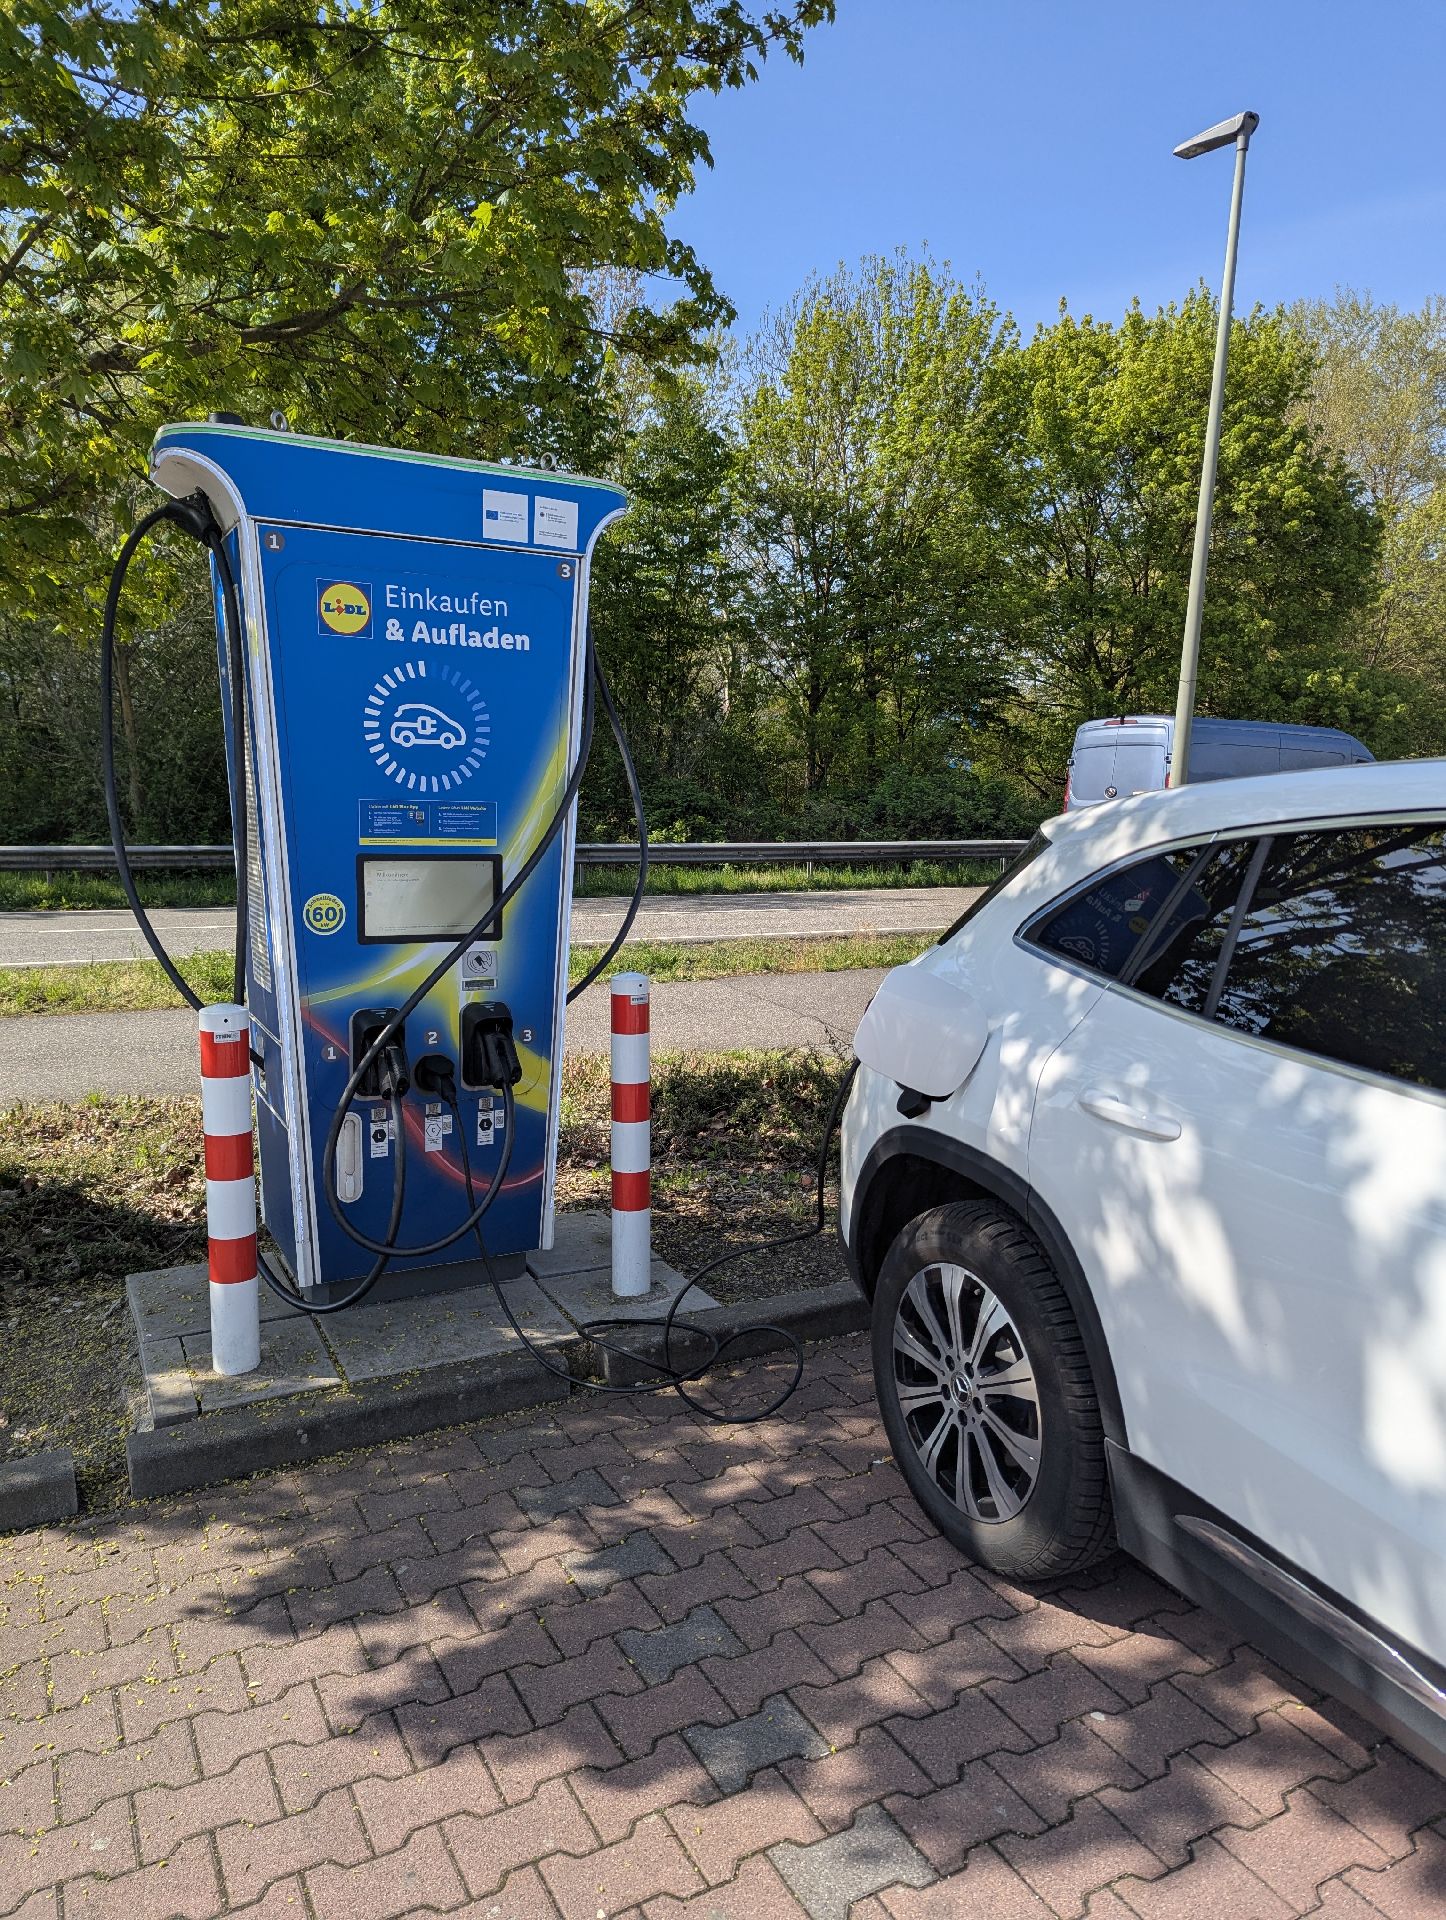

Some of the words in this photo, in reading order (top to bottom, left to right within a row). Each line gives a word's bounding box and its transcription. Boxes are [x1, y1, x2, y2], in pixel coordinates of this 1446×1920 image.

[269, 534, 280, 549] 1
[560, 564, 571, 578] 3
[386, 584, 508, 617] Einkaufen
[385, 618, 405, 642] &
[411, 620, 530, 651] Aufladen
[312, 906, 337, 923] 60
[428, 1030, 438, 1045] 2
[523, 1029, 532, 1042] 3
[327, 1046, 337, 1060] 1
